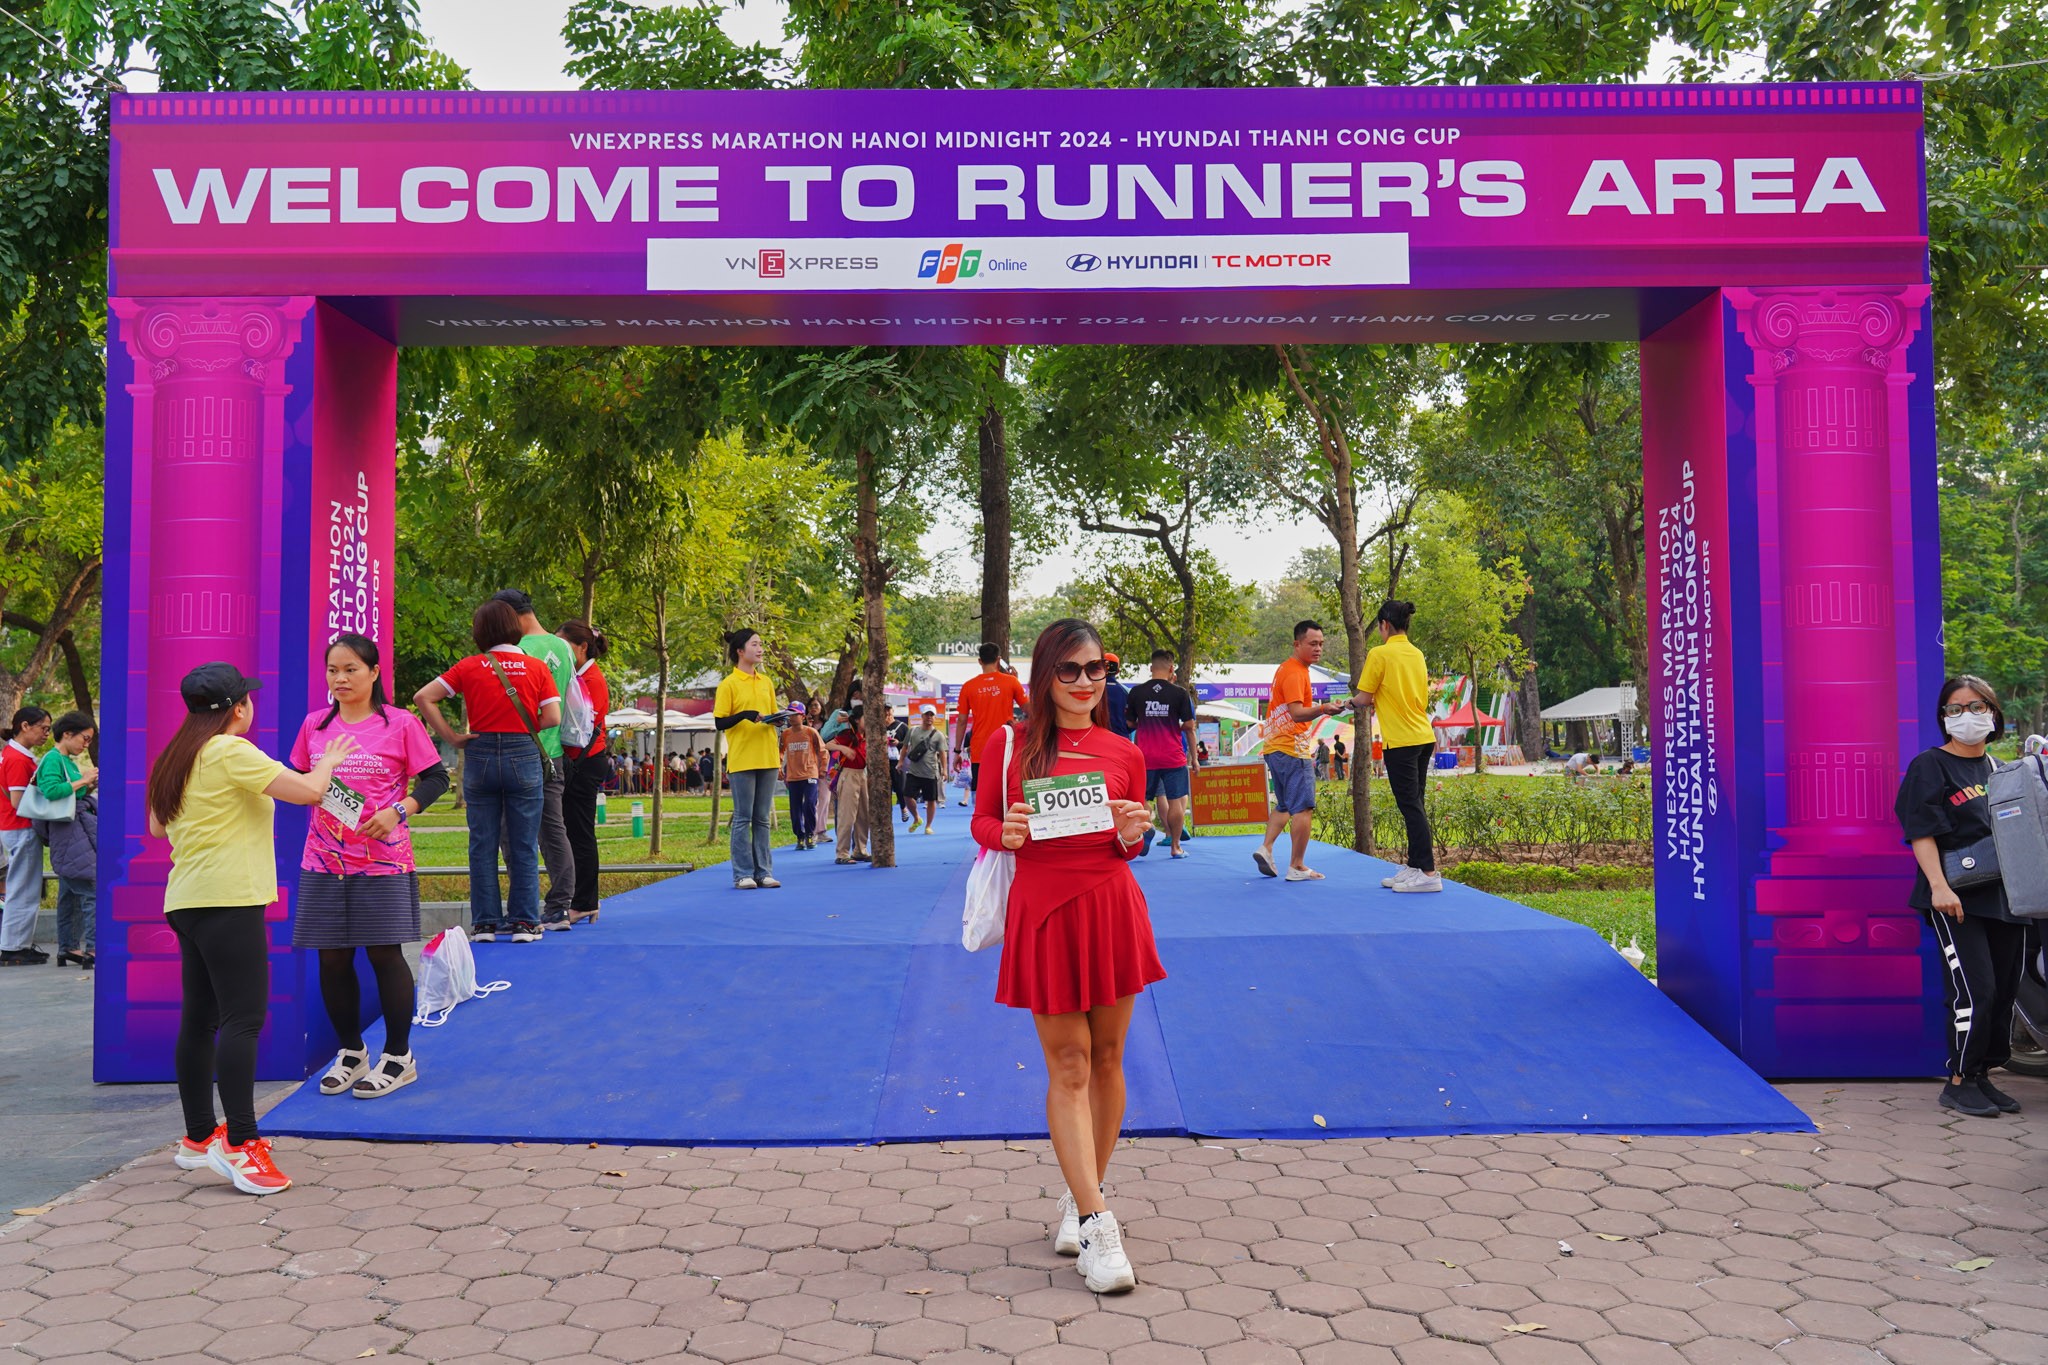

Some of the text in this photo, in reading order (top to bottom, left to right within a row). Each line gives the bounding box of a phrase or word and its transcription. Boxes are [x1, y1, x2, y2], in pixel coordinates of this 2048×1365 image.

[569, 132, 703, 150] VNEXPRESS
[711, 132, 844, 150] MARATHON
[851, 131, 926, 149] HANOI
[935, 131, 1051, 149] MIDNIGHT
[1059, 131, 1112, 148] 2024
[1136, 129, 1240, 148] HYUNDAI
[1248, 129, 1329, 147] THANH
[1336, 128, 1406, 146] CONG
[1413, 127, 1461, 145] CUP
[152, 165, 719, 225] WELCOME
[765, 164, 916, 222] TO
[1567, 156, 1886, 215] AREA
[725, 249, 879, 278] VNEXPRESS
[988, 258, 1027, 272] Online
[1107, 253, 1332, 270] HYUNDAI TC MOTOR
[426, 319, 607, 327] VNEXPRESS
[615, 318, 792, 327] MARATHON
[802, 318, 901, 327] HANOI
[913, 317, 1068, 326] MIDNIGHT
[1077, 316, 1147, 325] 2024
[1179, 315, 1318, 325] HYUNDAI
[1329, 315, 1437, 324] THANH
[1444, 314, 1537, 323] CONG
[1546, 313, 1612, 322] CUP
[328, 500, 342, 646] ARATHON
[342, 505, 354, 583] 2024
[355, 471, 369, 635] CONG CUP
[371, 559, 380, 643] MOTOR
[978, 685, 1000, 694] LEVEL
[1659, 507, 1678, 859] VNEXPRESS MARATHON
[1670, 502, 1690, 861] HANOI MIDNIGHT 2024
[1682, 460, 1705, 900] HYUNDAI THANH CONG CUP
[1702, 540, 1716, 773] HYUNDAI TC MOTOR
[1224, 688, 1234, 697] BIB
[1234, 688, 1247, 697] PICK
[1248, 688, 1255, 697] UP
[1255, 688, 1269, 697] AND
[1043, 786, 1104, 811] 90105
